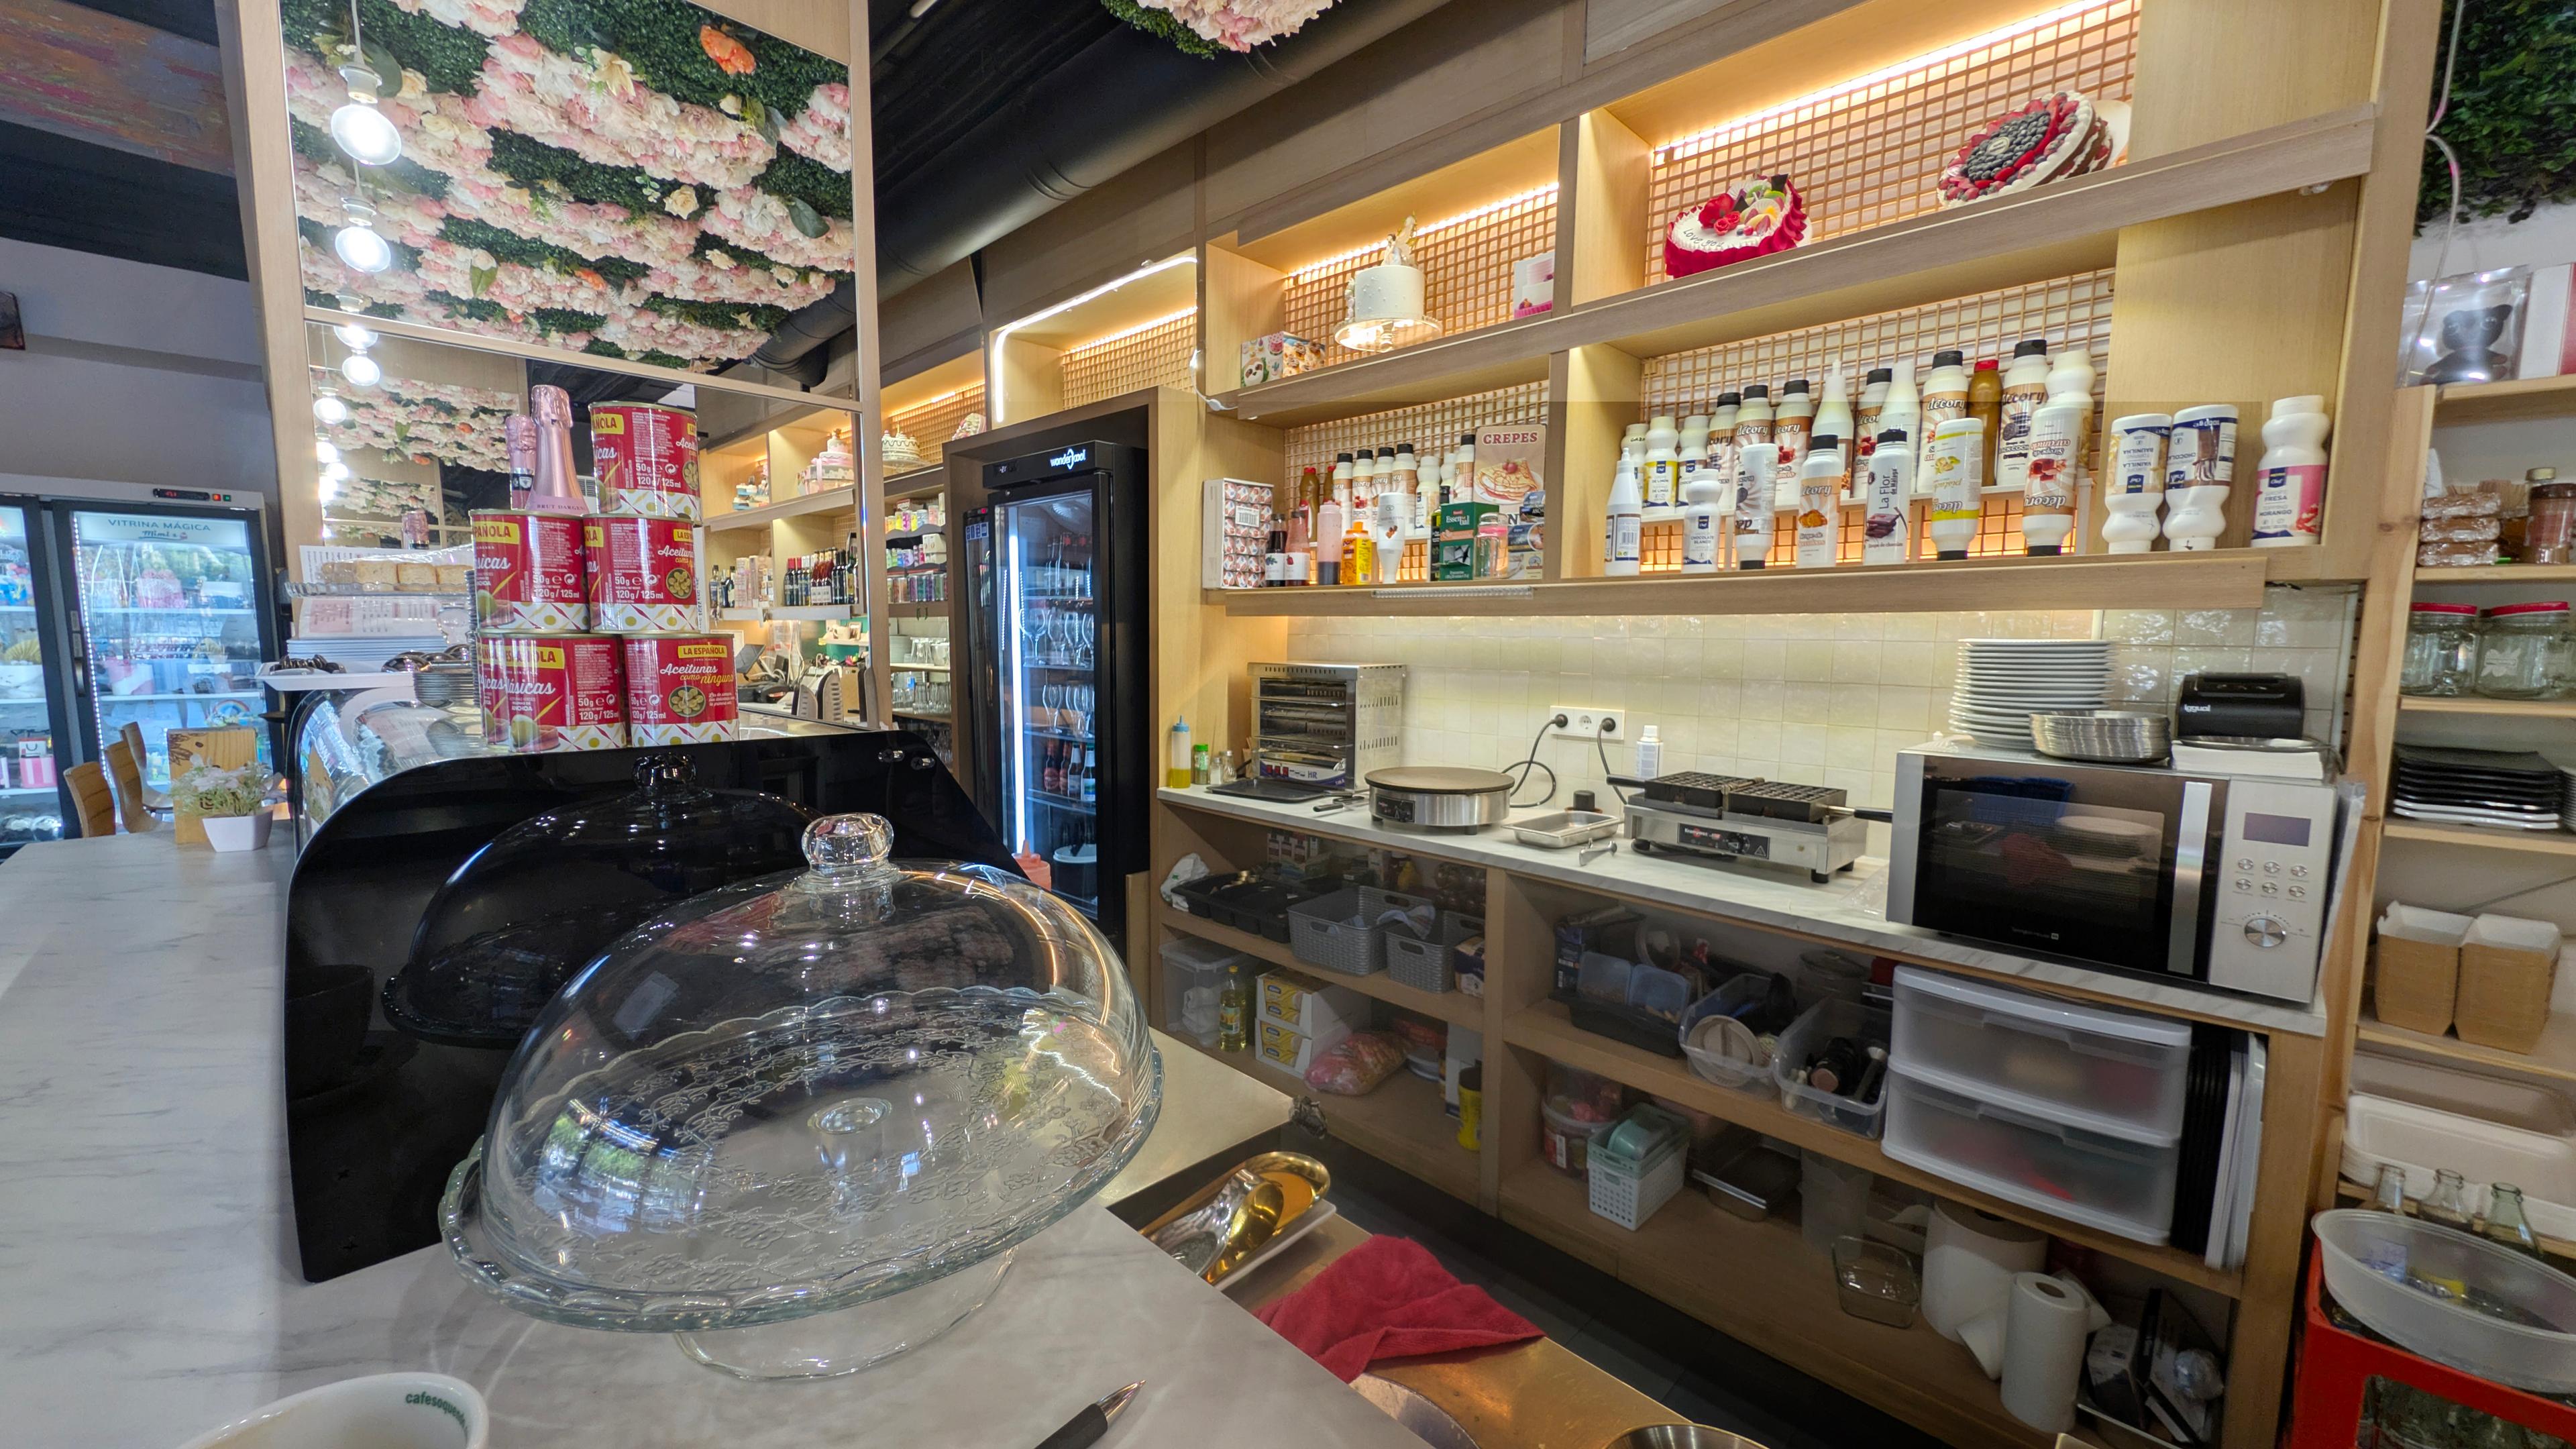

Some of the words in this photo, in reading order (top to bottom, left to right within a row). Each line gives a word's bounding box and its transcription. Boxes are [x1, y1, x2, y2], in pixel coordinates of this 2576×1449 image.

[1483, 432, 1538, 445] CREPES
[108, 519, 159, 529] VITRINA
[163, 521, 211, 531] MÁGICA
[694, 646, 725, 655] ESPAÑOLA
[660, 663, 718, 676] Aceitunas
